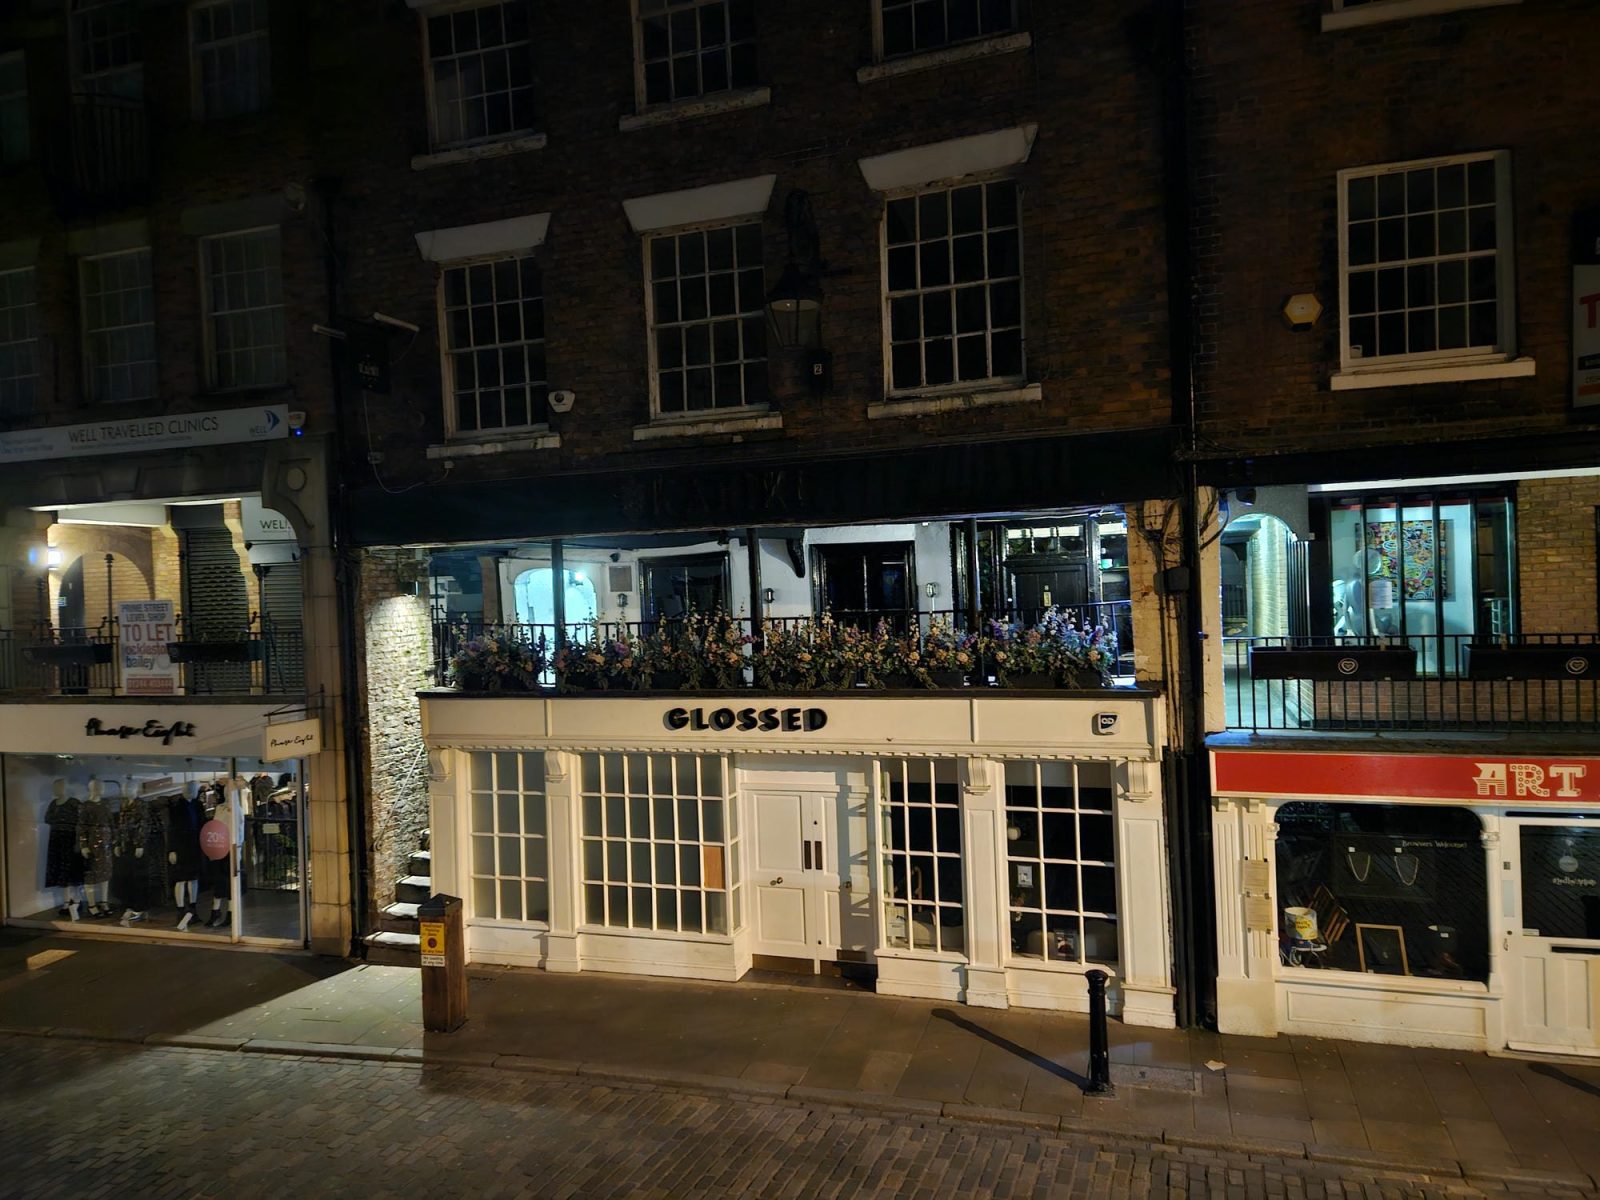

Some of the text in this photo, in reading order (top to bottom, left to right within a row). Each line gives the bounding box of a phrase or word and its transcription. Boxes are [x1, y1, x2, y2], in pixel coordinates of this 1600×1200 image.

[68, 428, 97, 443] WELL
[101, 421, 164, 440] TRAVELLED
[167, 415, 219, 435] CLINICS
[249, 425, 268, 434] WELL
[144, 603, 169, 612] STREET
[148, 613, 166, 621] SHOP
[122, 623, 173, 641] TO LET
[126, 655, 155, 670] bailey
[663, 707, 828, 732] GLOSSED
[142, 719, 197, 745] Eight
[294, 734, 314, 745] Eight
[1472, 763, 1587, 797] ART
